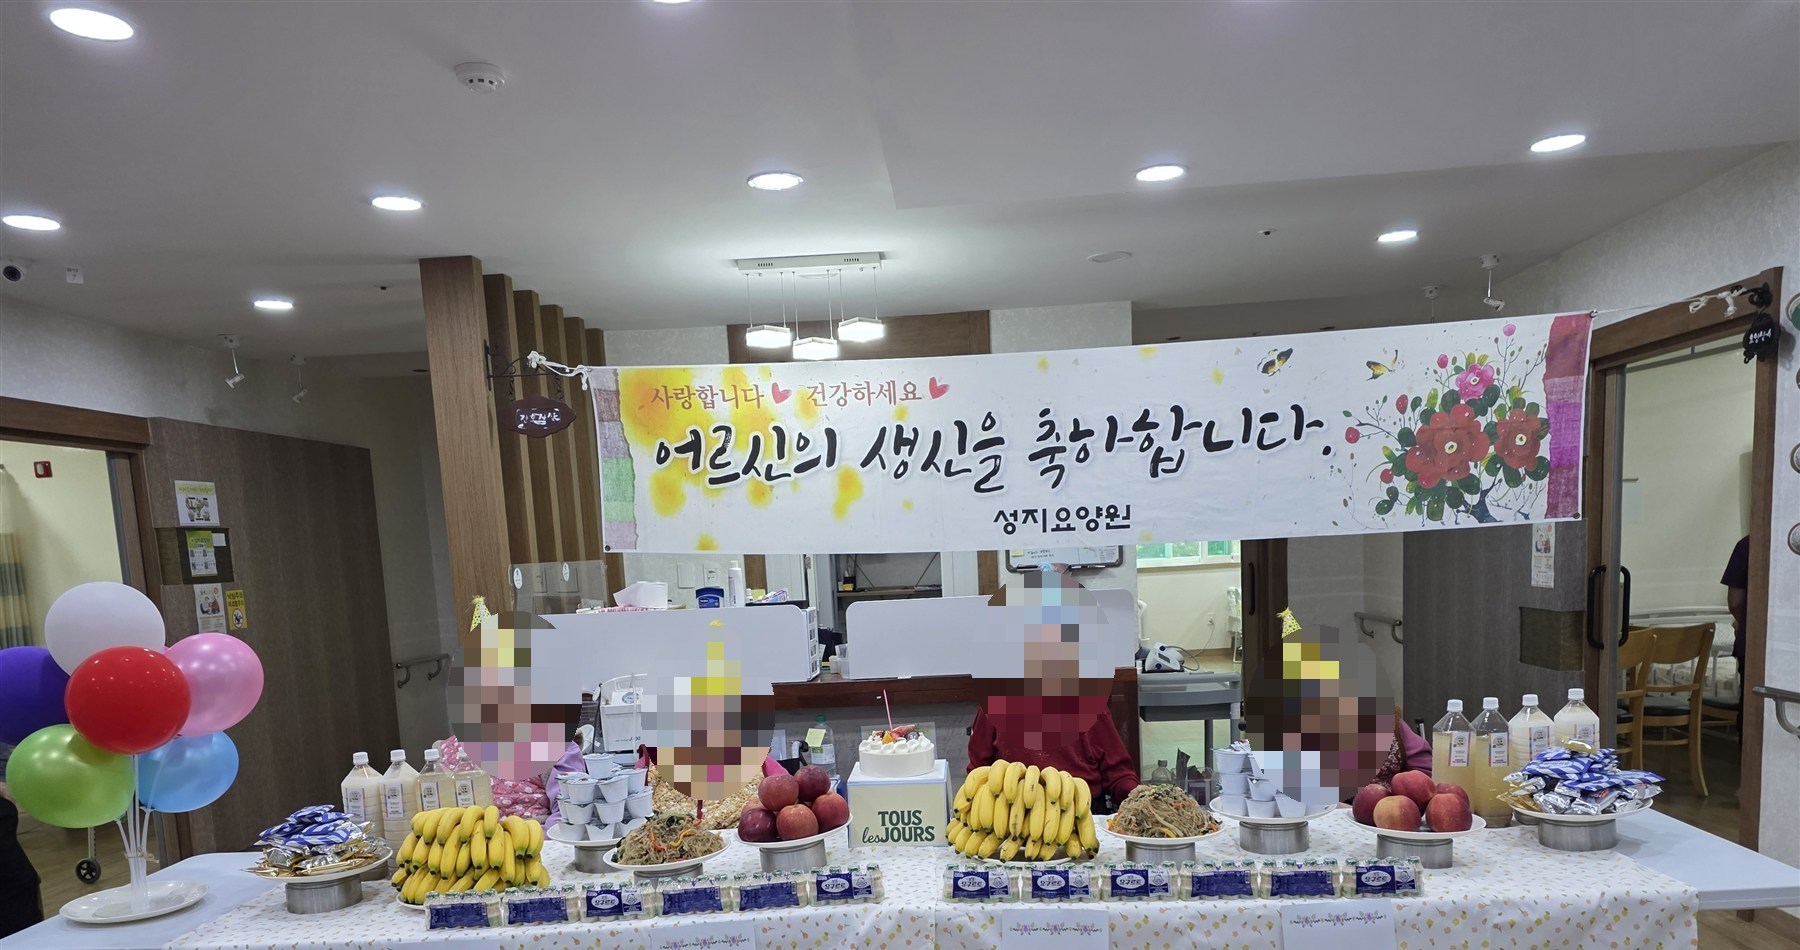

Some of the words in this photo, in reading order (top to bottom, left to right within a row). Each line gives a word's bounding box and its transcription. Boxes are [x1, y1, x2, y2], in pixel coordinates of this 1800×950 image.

[650, 384, 765, 410] 사랑합니다
[805, 377, 923, 407] 건강하세요
[655, 425, 835, 485] 어르신의
[860, 412, 1006, 493] 생신을
[1028, 404, 1333, 489] 축하합니다.
[993, 503, 1132, 536] 성지요양원
[862, 827, 880, 843] les
[878, 826, 935, 843] JOURS
[878, 810, 922, 827] TOUS
